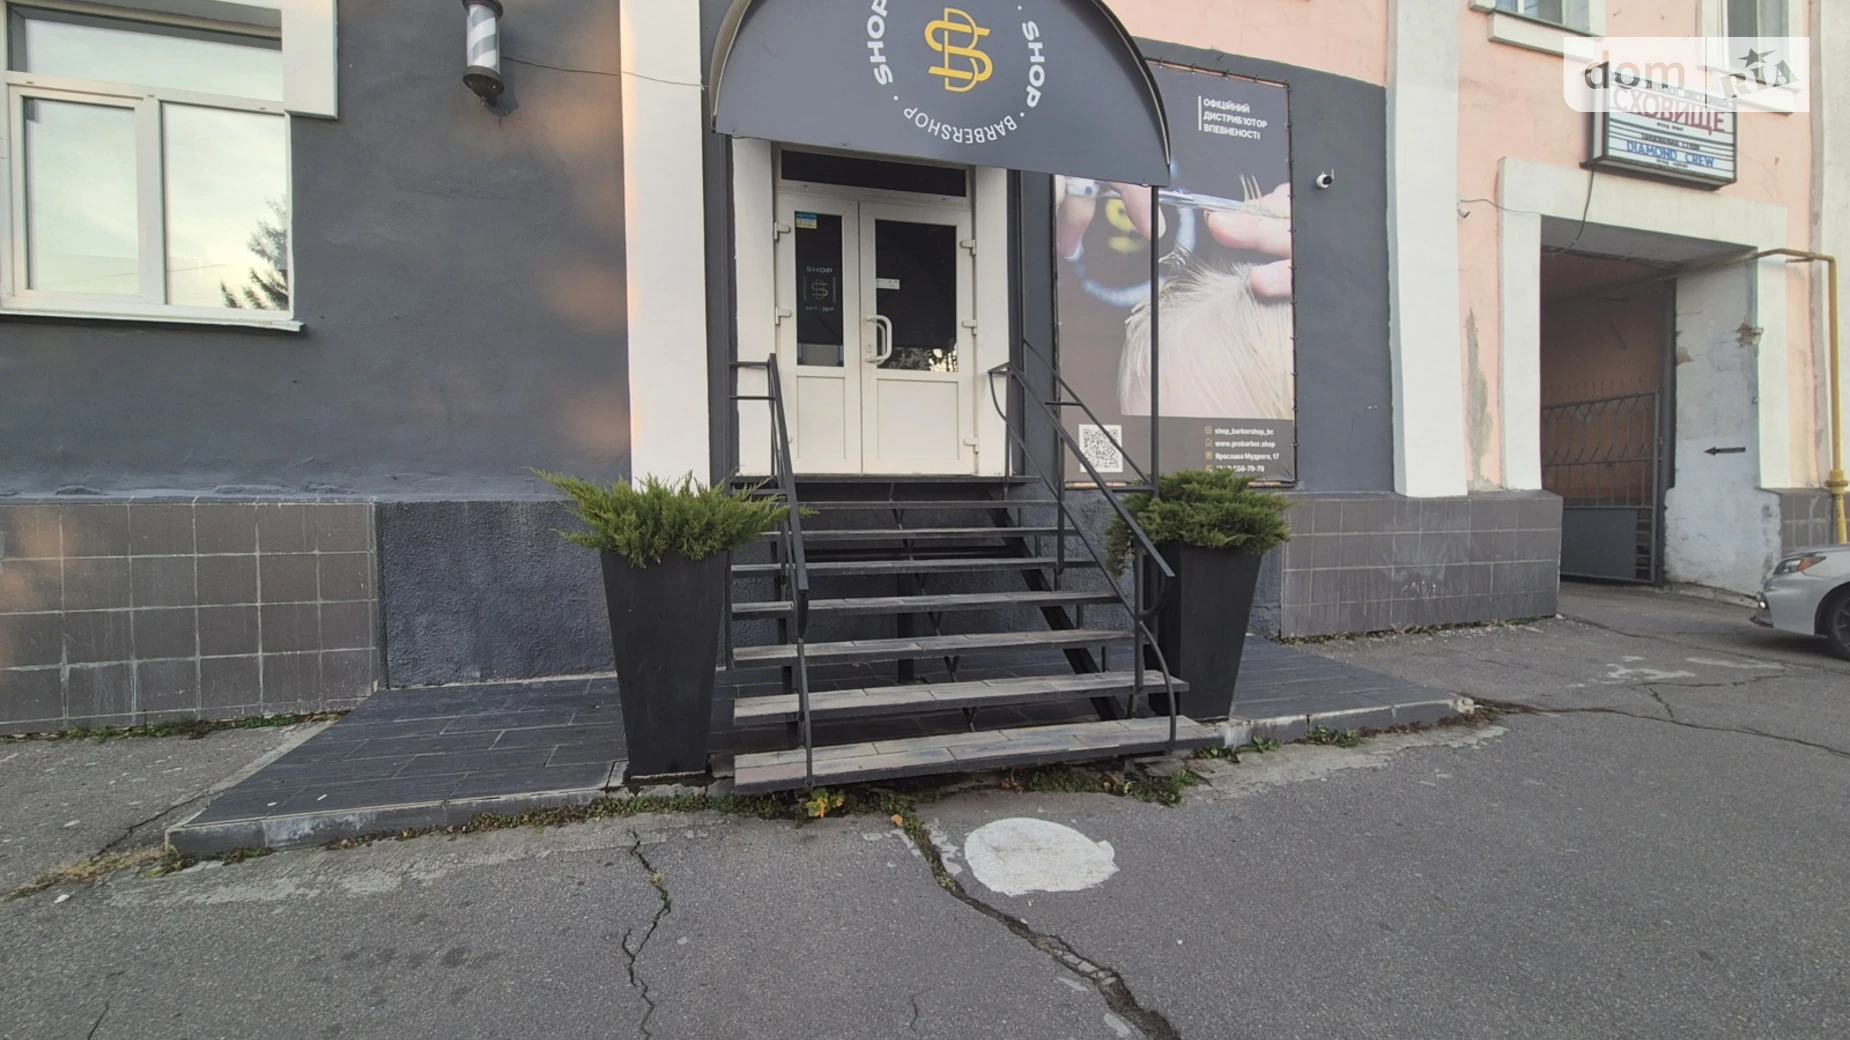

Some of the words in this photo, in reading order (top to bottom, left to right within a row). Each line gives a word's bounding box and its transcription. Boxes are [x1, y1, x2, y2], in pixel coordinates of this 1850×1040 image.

[1022, 21, 1046, 108] SHOP
[1203, 98, 1251, 113] ОФІЦІЙНИЙ
[1613, 87, 1726, 136] СХОВИЩЕ
[904, 107, 1018, 144] BARBERSHOP
[1203, 123, 1261, 140] ВПЕВНЕНОСТІ
[1626, 139, 1678, 161] DIAMOND
[1685, 152, 1716, 168] CREW
[806, 266, 833, 274] SHOP
